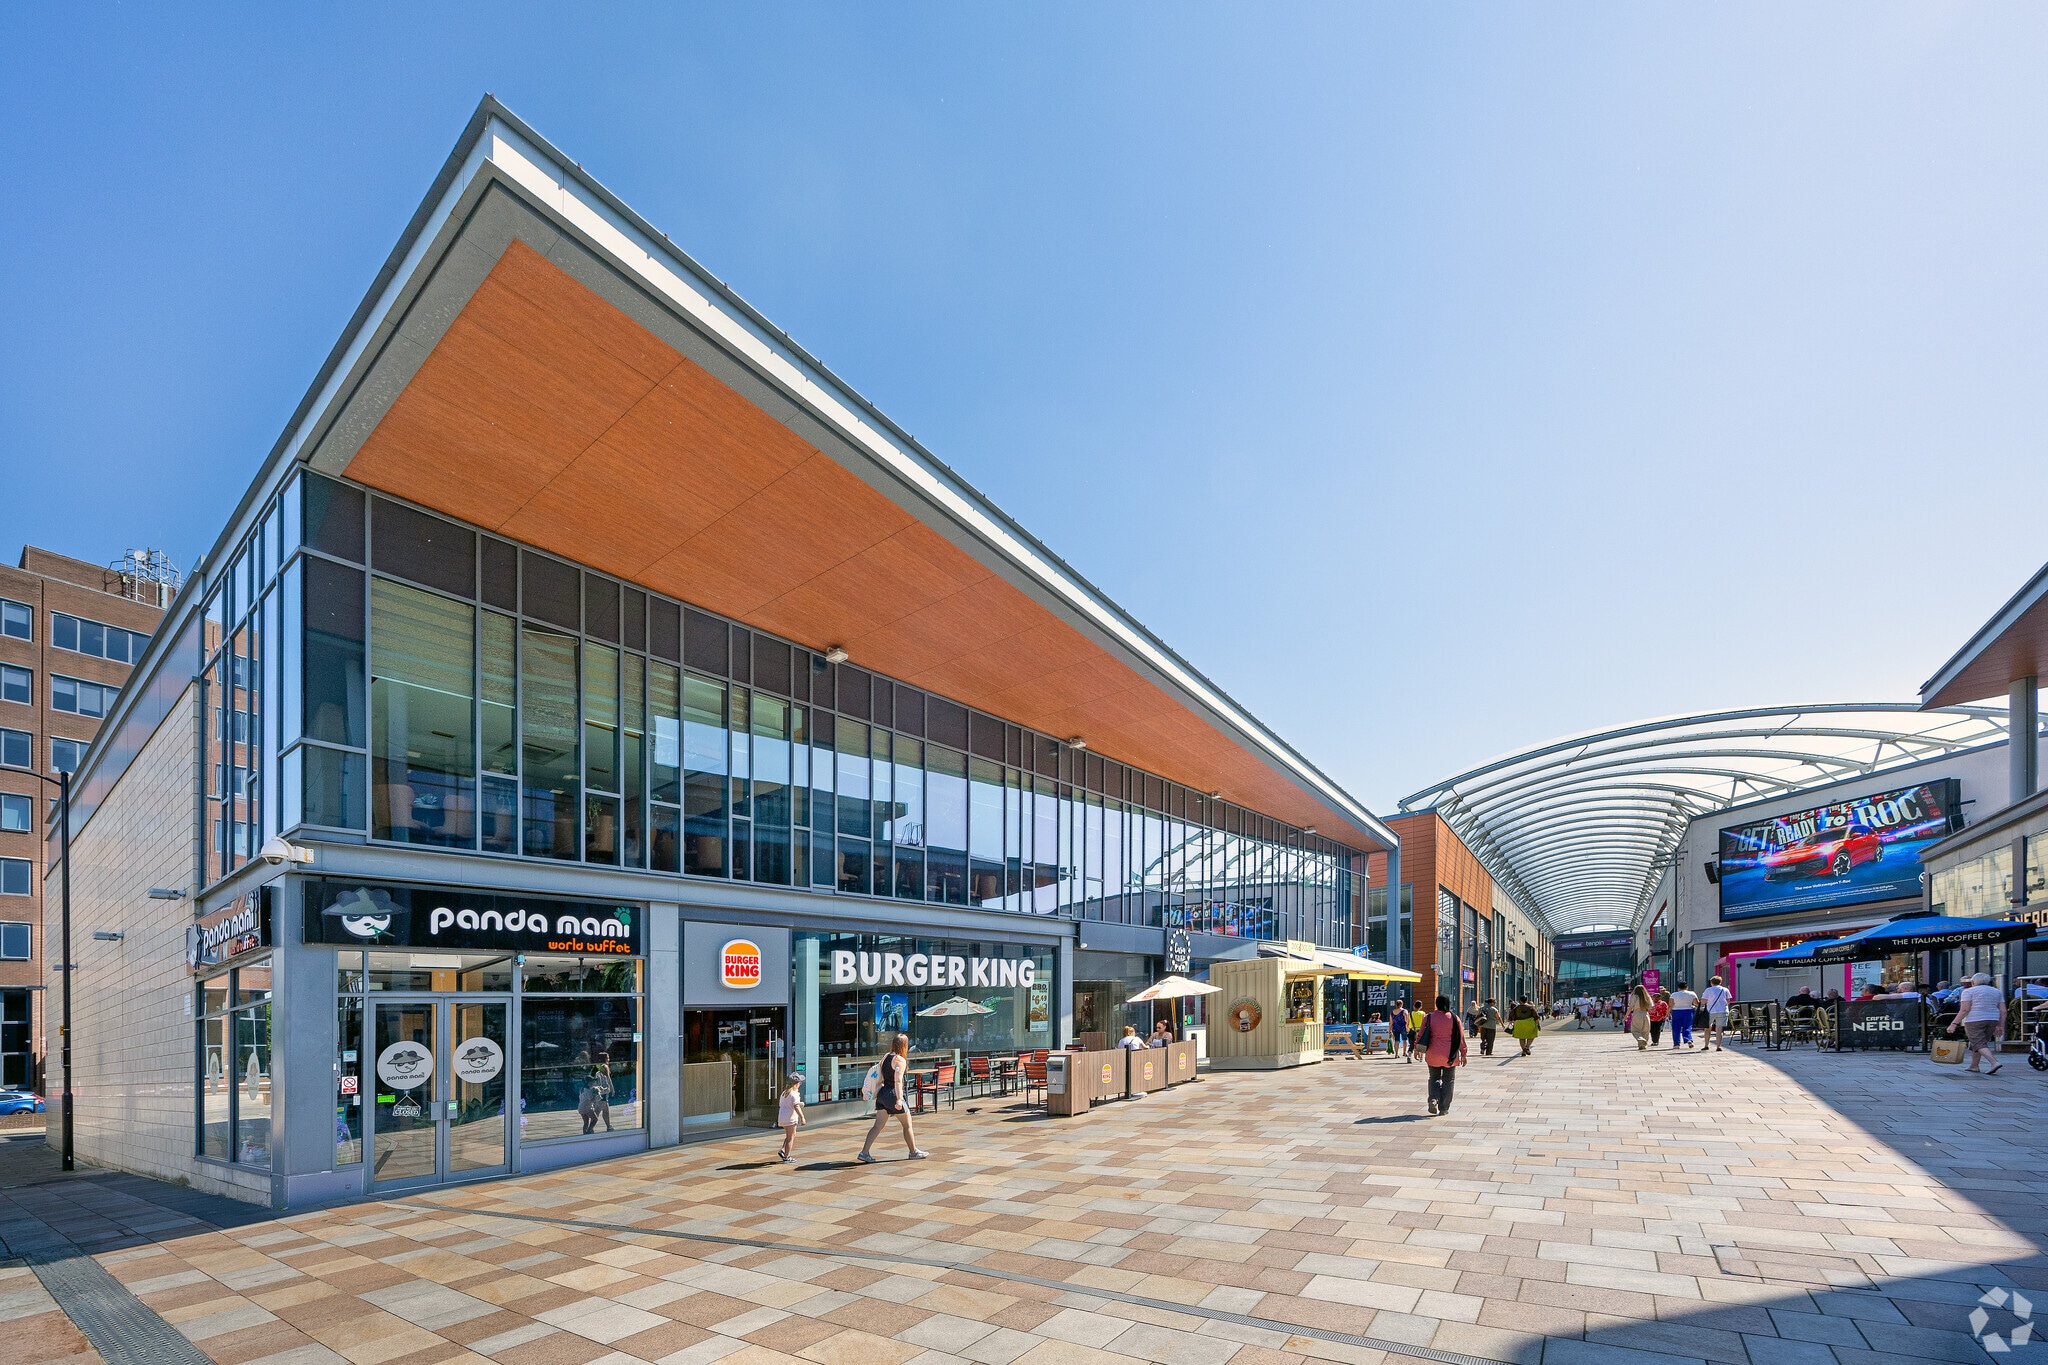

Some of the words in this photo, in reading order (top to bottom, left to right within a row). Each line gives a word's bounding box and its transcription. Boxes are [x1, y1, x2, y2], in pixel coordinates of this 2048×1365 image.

[1738, 826, 1771, 852] GET
[1776, 817, 1816, 845] READY
[1824, 815, 1846, 827] TO
[1854, 795, 1922, 828] ROC
[430, 907, 548, 935] panda
[556, 914, 630, 938] mami
[203, 918, 231, 957] panda
[1585, 939, 1605, 947] tenpin
[1911, 936, 1945, 944] ITALIAN
[1946, 933, 1983, 942] COFFEE
[548, 937, 584, 951] world
[586, 939, 631, 953] buffet
[725, 955, 759, 965] BURGER
[725, 964, 759, 977] KING
[831, 950, 966, 987] BURGER
[968, 956, 1035, 988] KING
[1852, 1020, 1904, 1032] NERO
